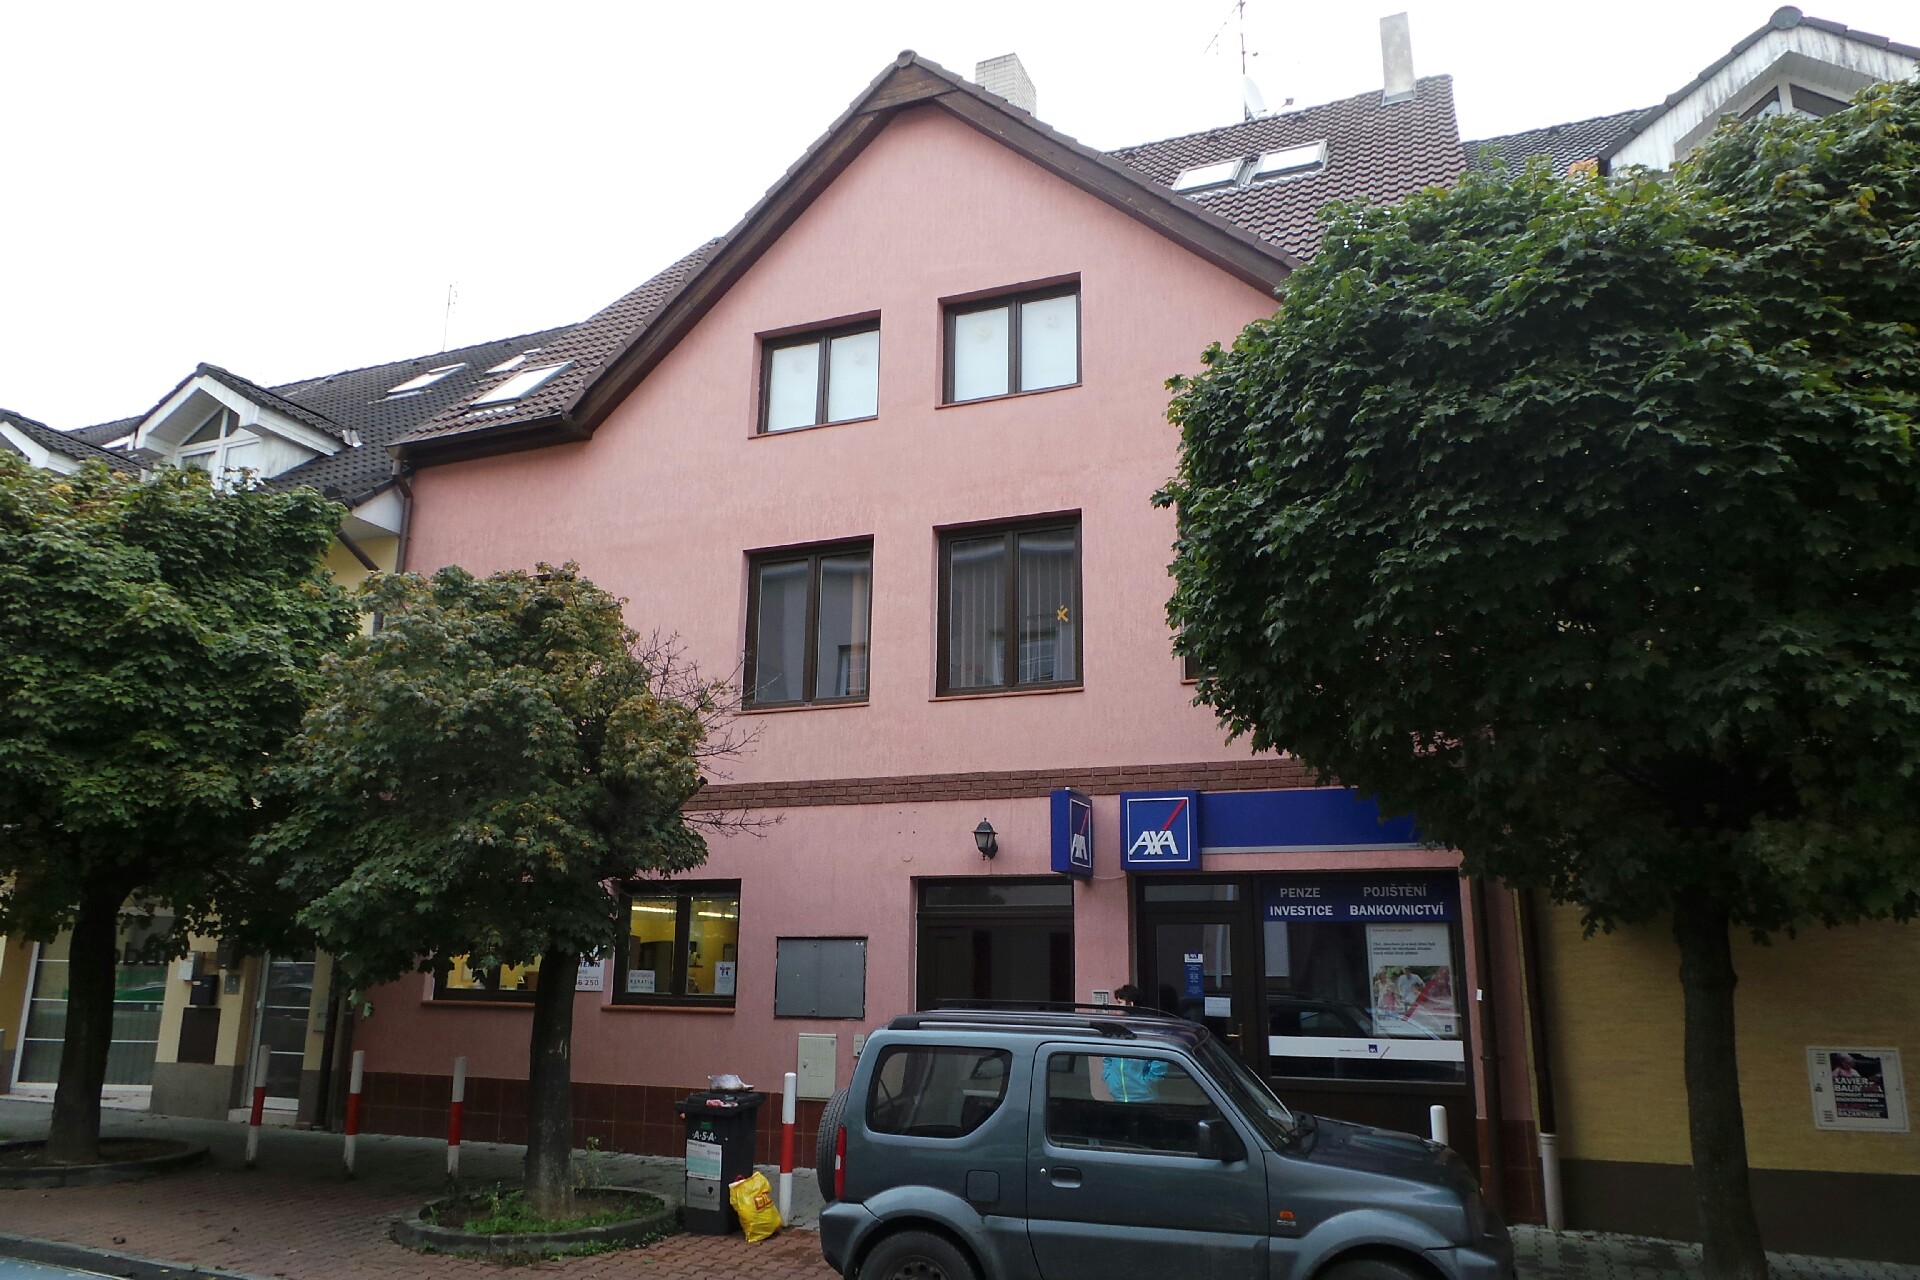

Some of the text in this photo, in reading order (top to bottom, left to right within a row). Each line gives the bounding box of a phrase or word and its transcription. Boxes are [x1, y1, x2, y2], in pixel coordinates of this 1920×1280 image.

[1071, 833, 1088, 860] AXA
[1129, 830, 1179, 856] AXA
[1280, 887, 1321, 898] PENZE
[1363, 883, 1428, 897] POJIŠTĚNÍ
[1270, 905, 1333, 916] INVESTICE
[1350, 901, 1444, 916] BANKOVNICTVÍ
[1834, 1077, 1868, 1085] XAVIER
